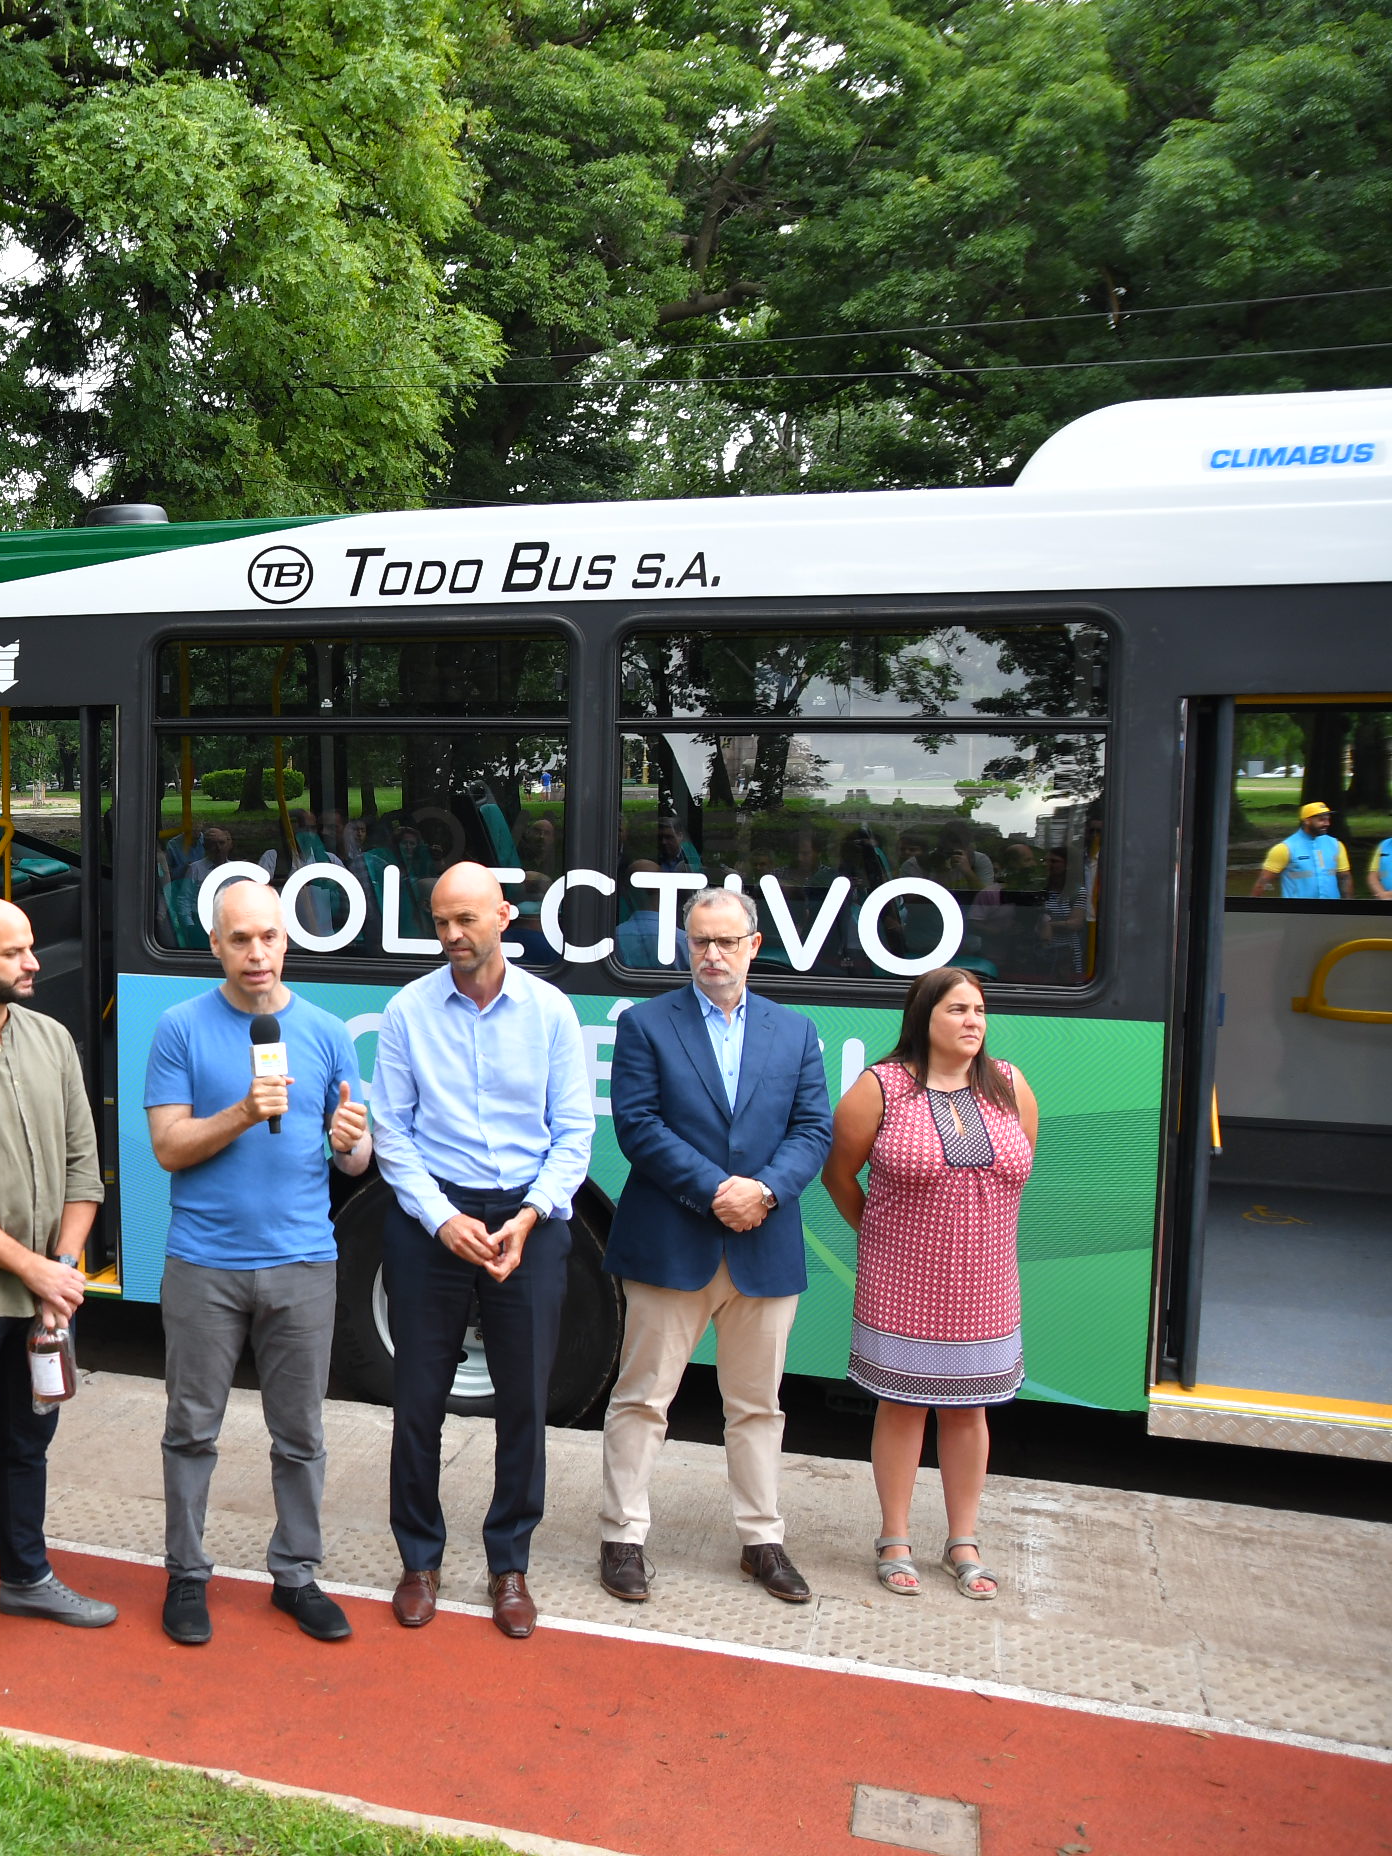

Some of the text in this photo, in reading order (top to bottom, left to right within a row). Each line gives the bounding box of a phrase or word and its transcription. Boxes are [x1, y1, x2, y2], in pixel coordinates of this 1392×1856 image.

[1210, 443, 1376, 469] CLIMABUS
[255, 562, 306, 588] TB
[631, 551, 721, 589] S.A.
